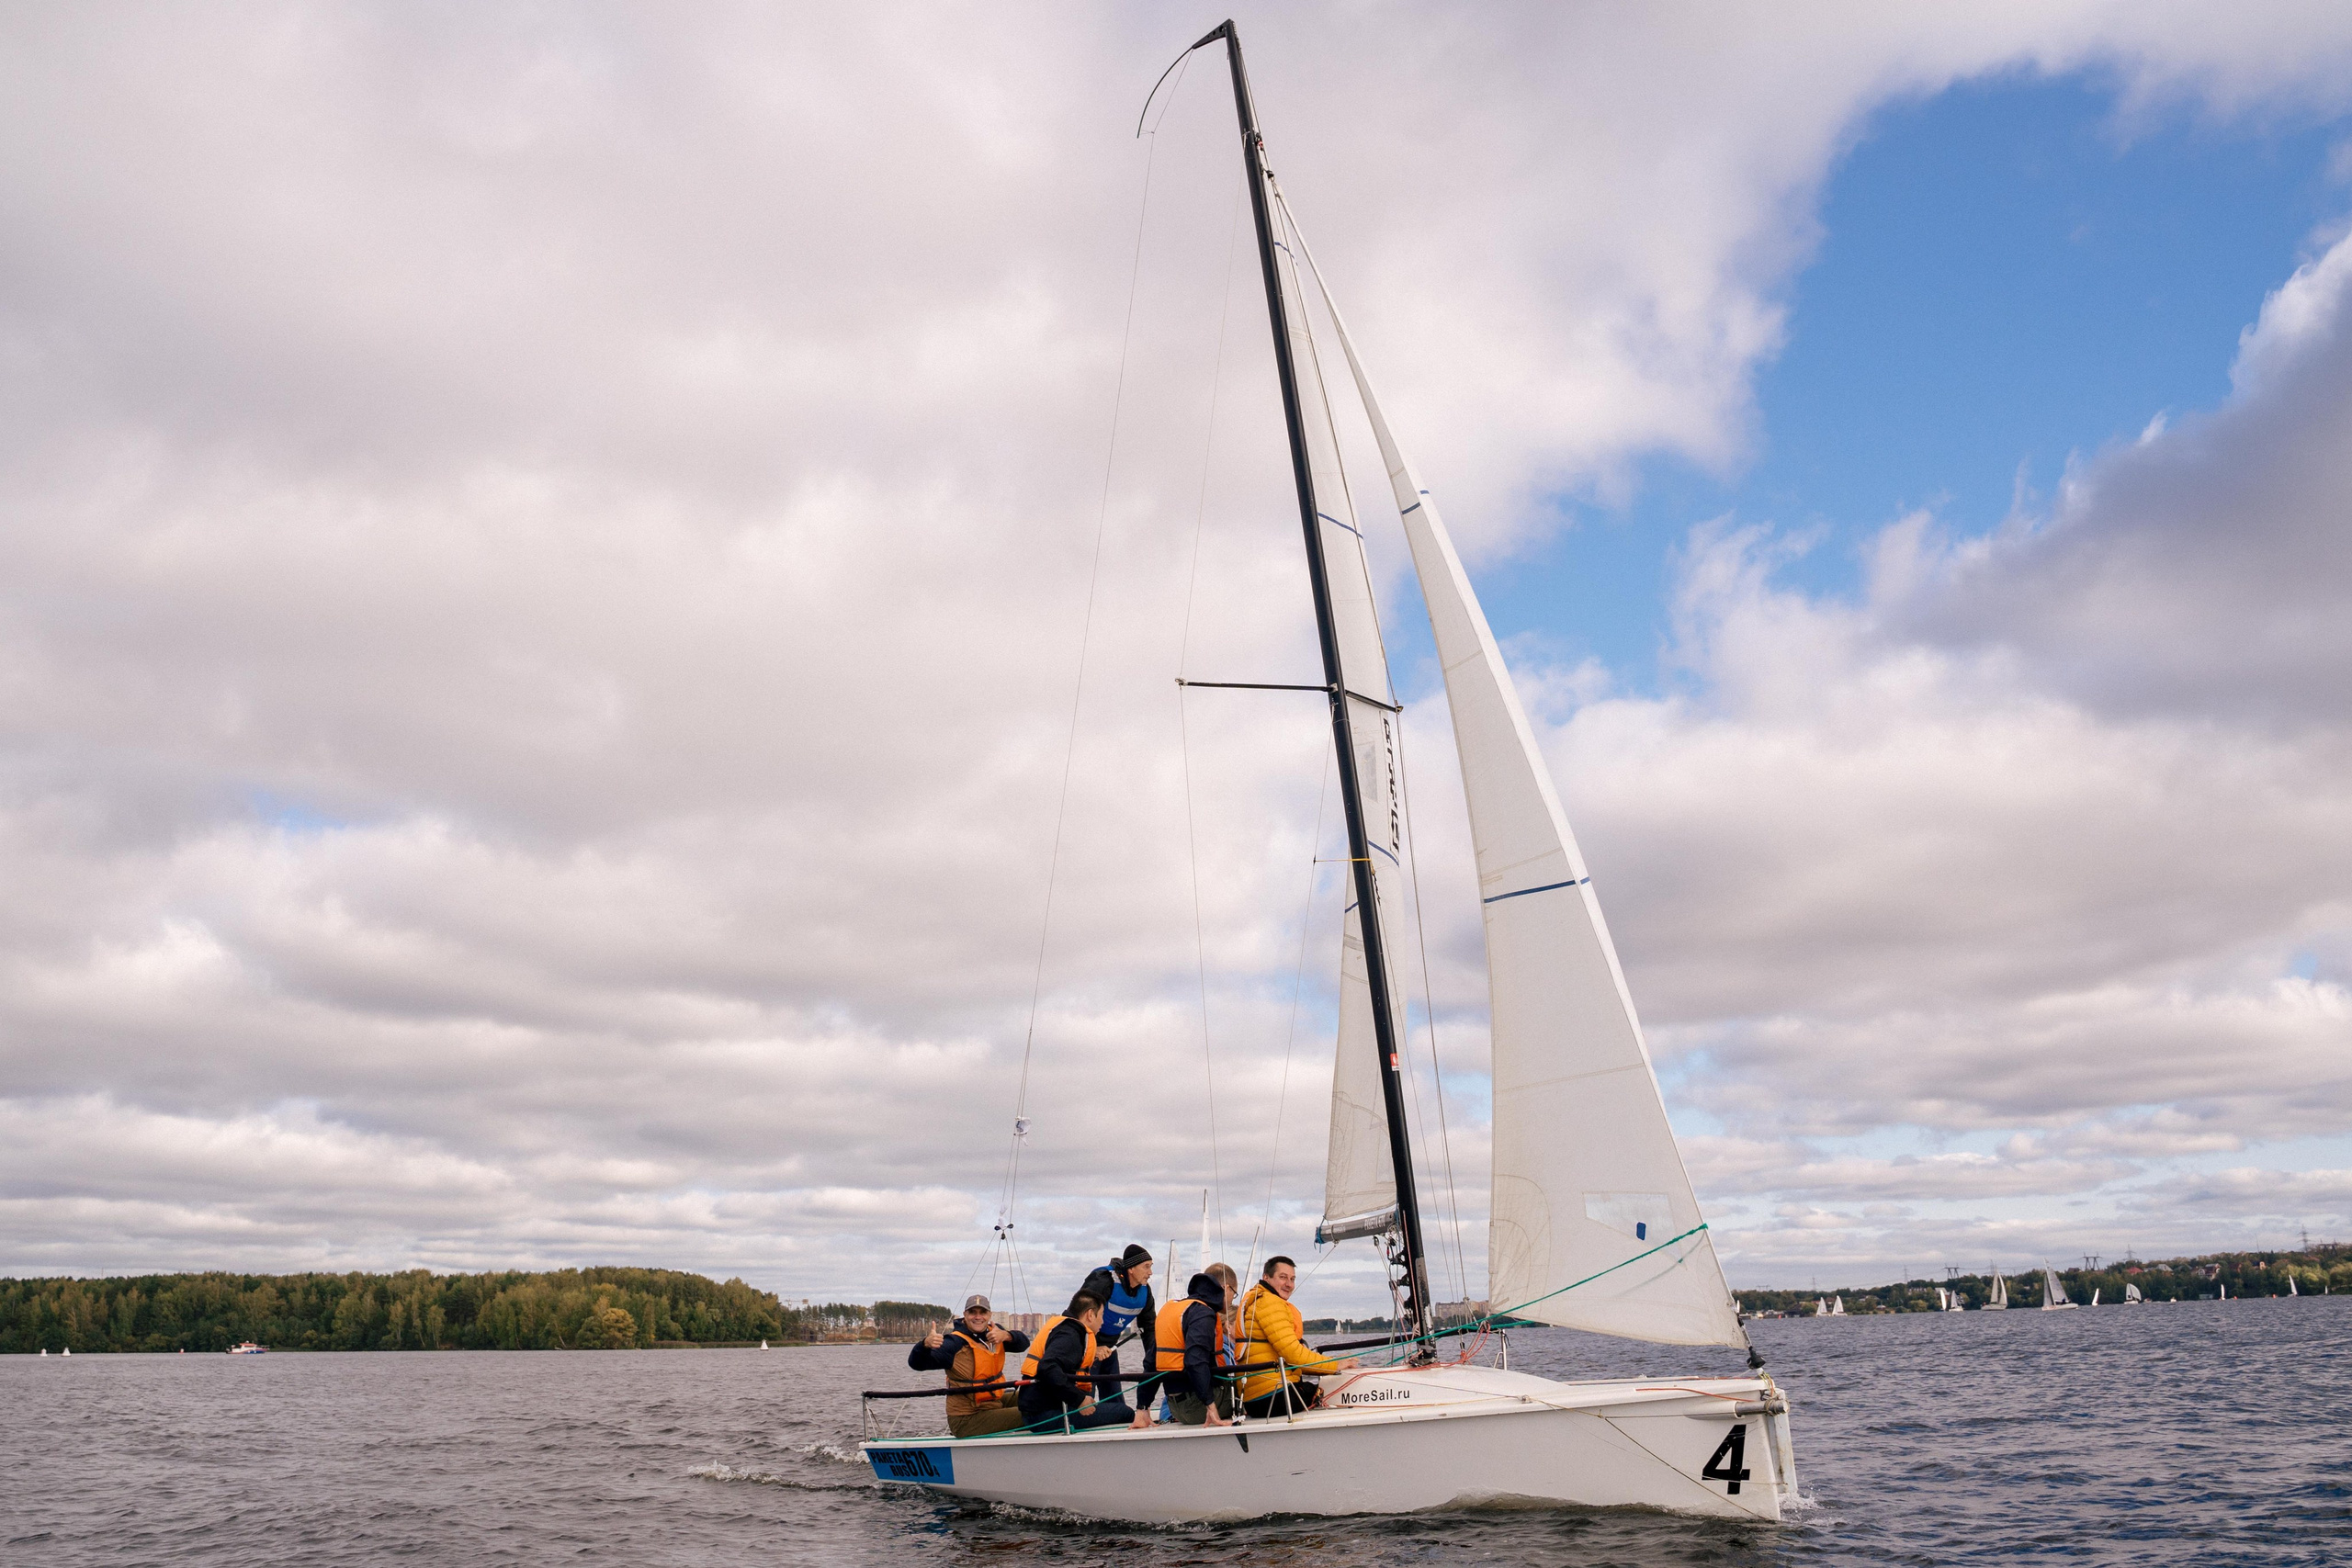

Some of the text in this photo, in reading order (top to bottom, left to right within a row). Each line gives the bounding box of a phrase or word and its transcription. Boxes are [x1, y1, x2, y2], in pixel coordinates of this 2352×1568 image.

[1341, 1388, 1410, 1404] MoreSail.ru
[869, 1451, 905, 1464] РАКЕТА
[901, 1450, 934, 1477] 670
[1702, 1424, 1750, 1495] 4
[889, 1464, 910, 1477] RUS
